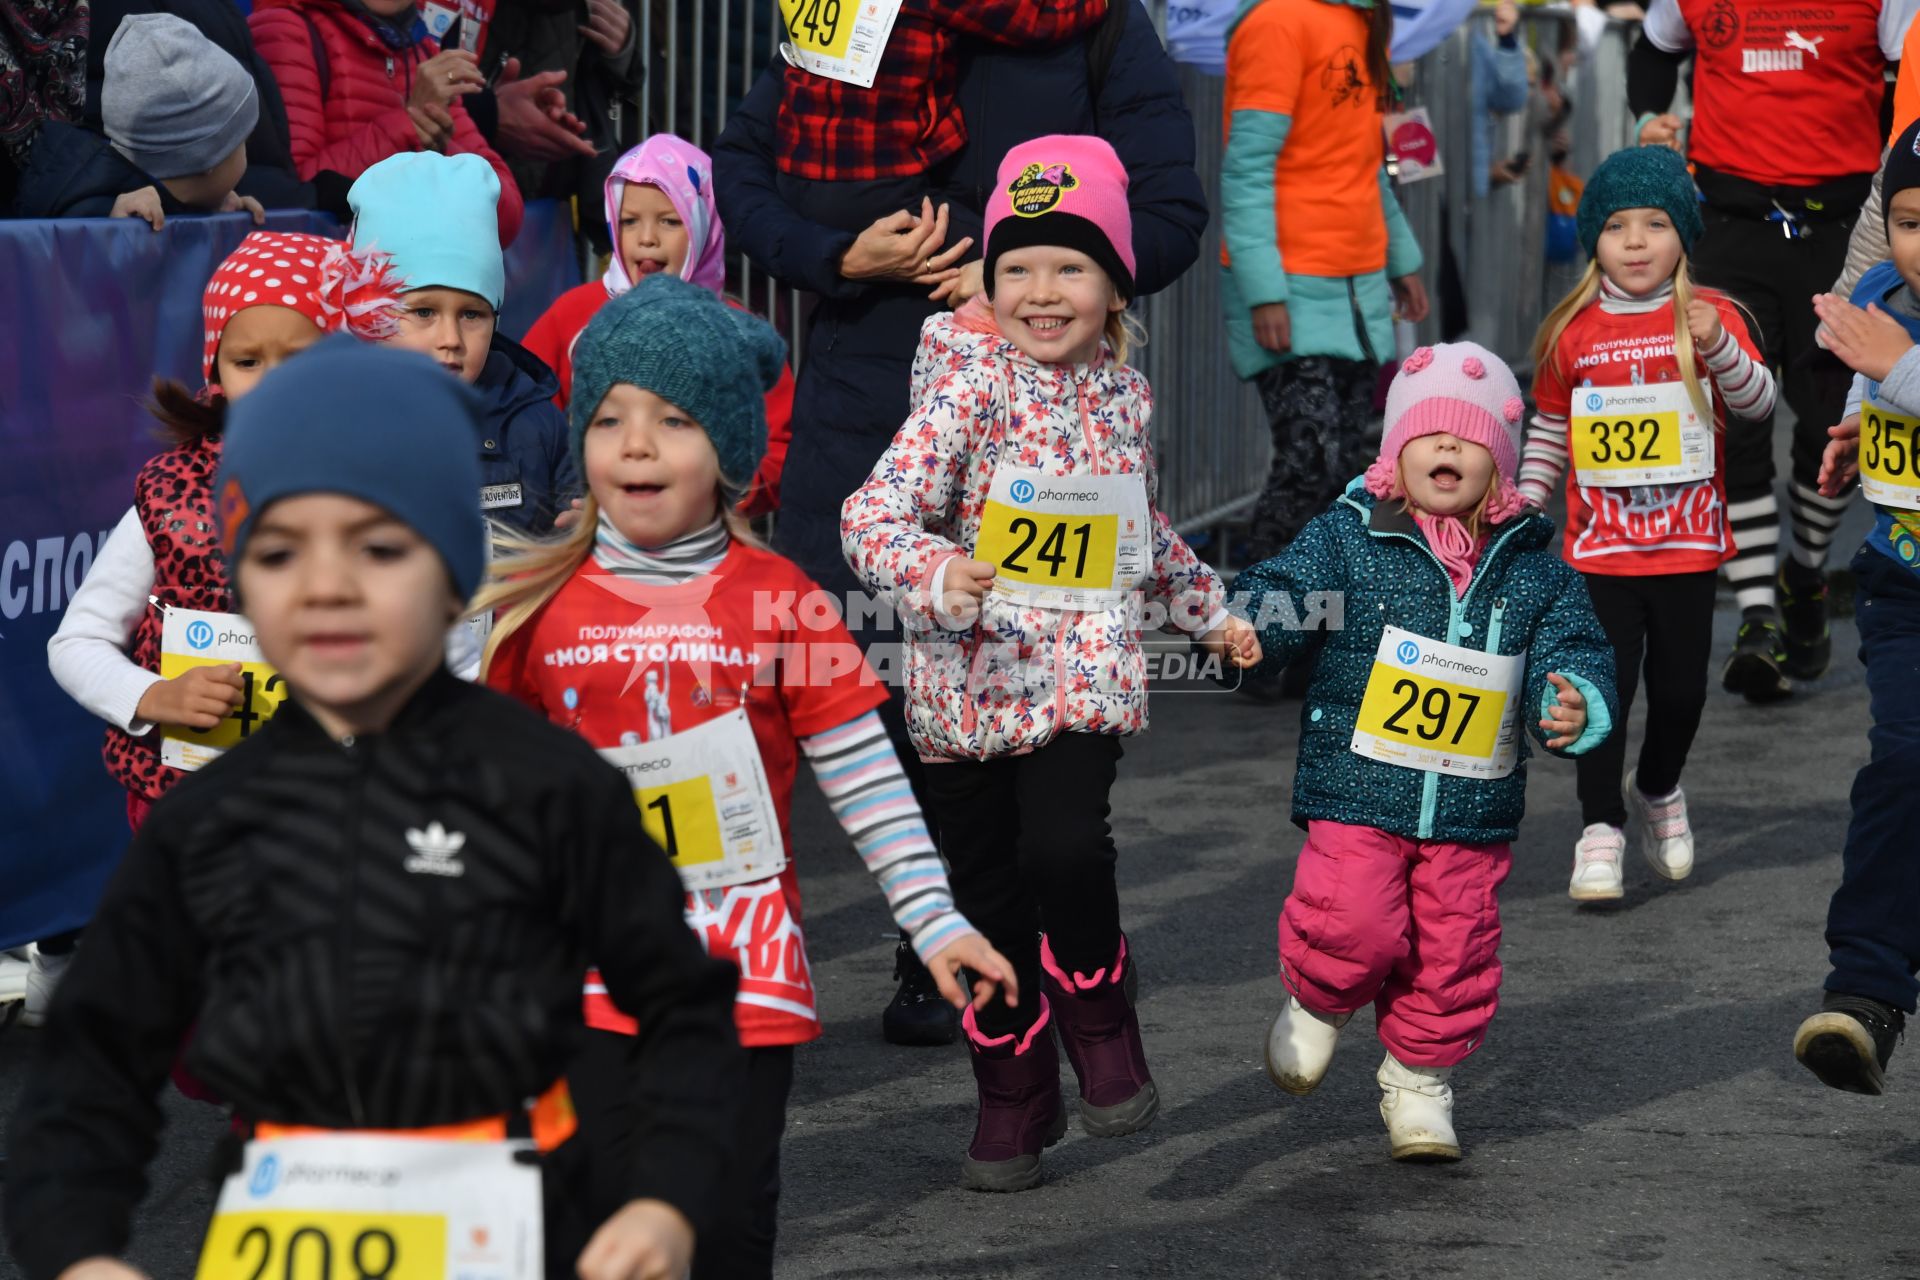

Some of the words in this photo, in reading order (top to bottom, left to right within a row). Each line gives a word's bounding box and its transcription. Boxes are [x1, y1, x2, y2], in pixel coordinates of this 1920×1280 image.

[789, 0, 841, 47] 249
[1015, 194, 1054, 208] MOUSE
[1016, 186, 1058, 199] MINNIE
[1592, 334, 1675, 352] ПОЛУМАРАФОН
[1612, 343, 1679, 362] СТОЛИЦ
[1605, 395, 1657, 407] pharmeco
[1589, 418, 1661, 463] 332
[1037, 488, 1099, 502] pharmeco
[1001, 517, 1091, 579] 241
[0, 530, 114, 620] СПО
[218, 630, 259, 646] phar
[579, 624, 723, 640] ПОЛУМАРАФОН
[544, 643, 608, 667] «МОЯ
[614, 642, 761, 667] СТОЛИЦА»
[1422, 653, 1488, 677] pharmeco
[1382, 678, 1480, 745] 297
[647, 794, 678, 858] 1
[234, 1225, 399, 1280] 208
